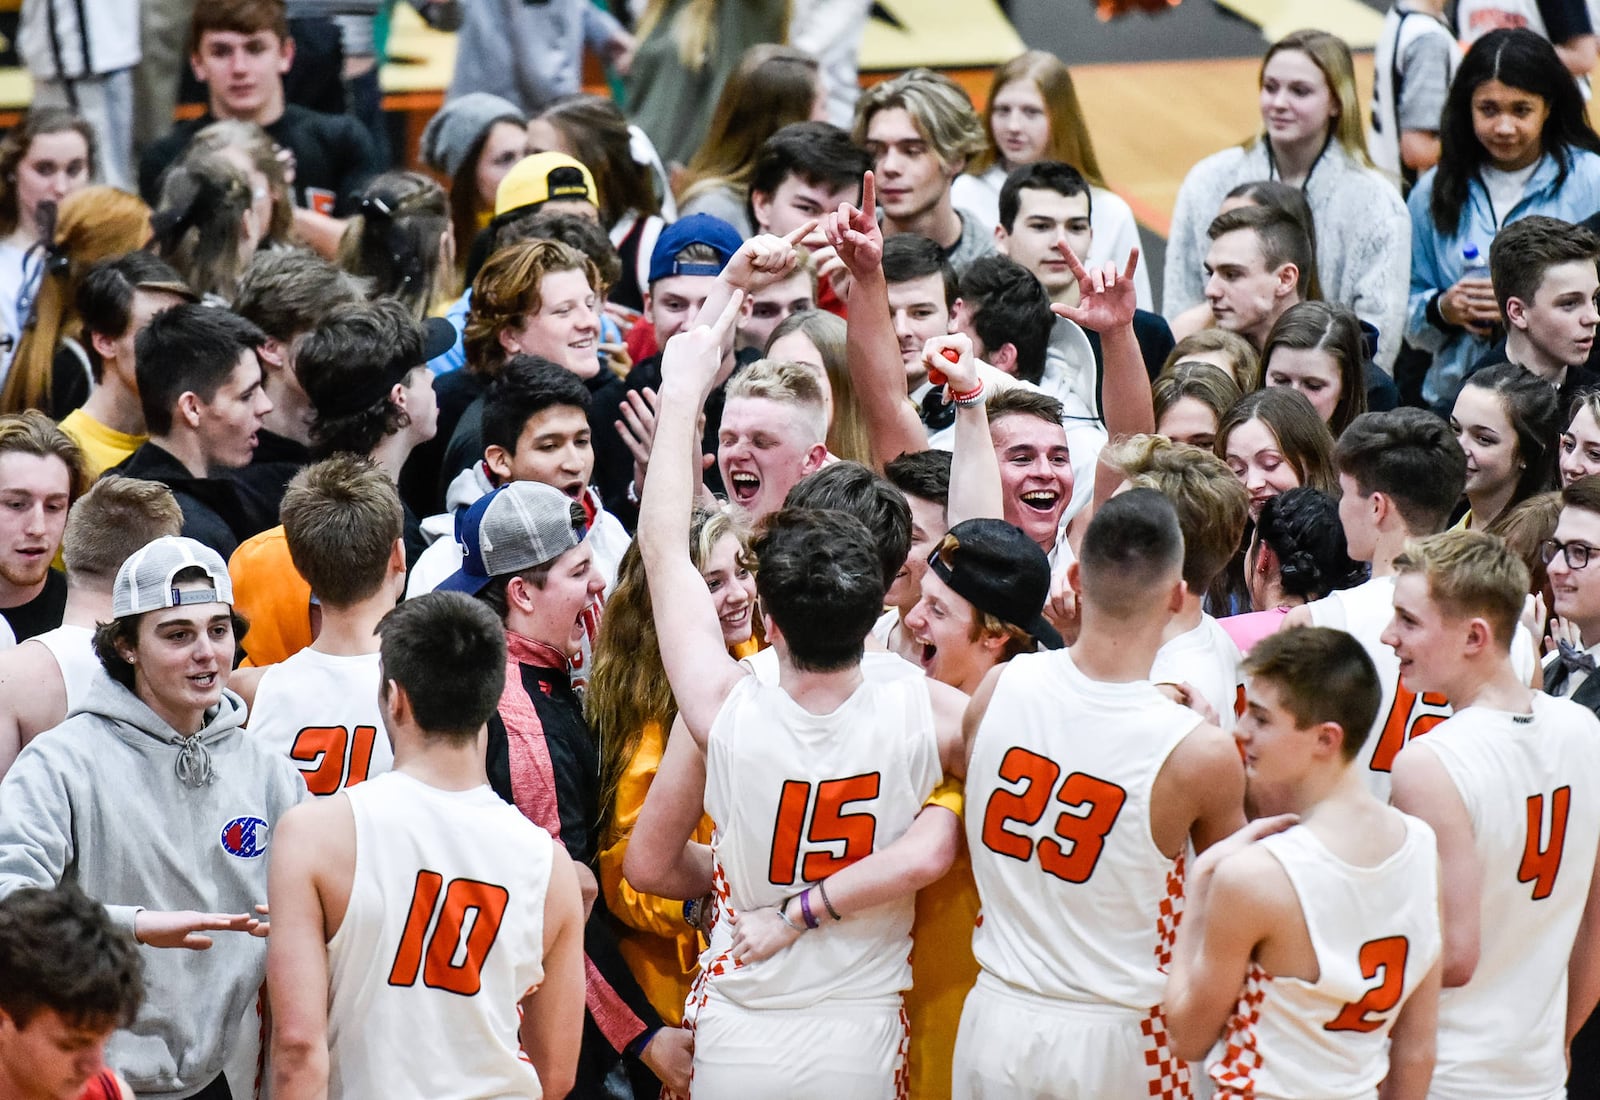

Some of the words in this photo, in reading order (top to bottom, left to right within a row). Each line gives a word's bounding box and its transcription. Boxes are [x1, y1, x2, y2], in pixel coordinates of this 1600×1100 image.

[289, 725, 377, 796] 21
[982, 748, 1125, 884] 23
[768, 771, 881, 886] 15
[1519, 787, 1570, 901] 4
[387, 869, 509, 997] 10
[1325, 937, 1407, 1032] 2
